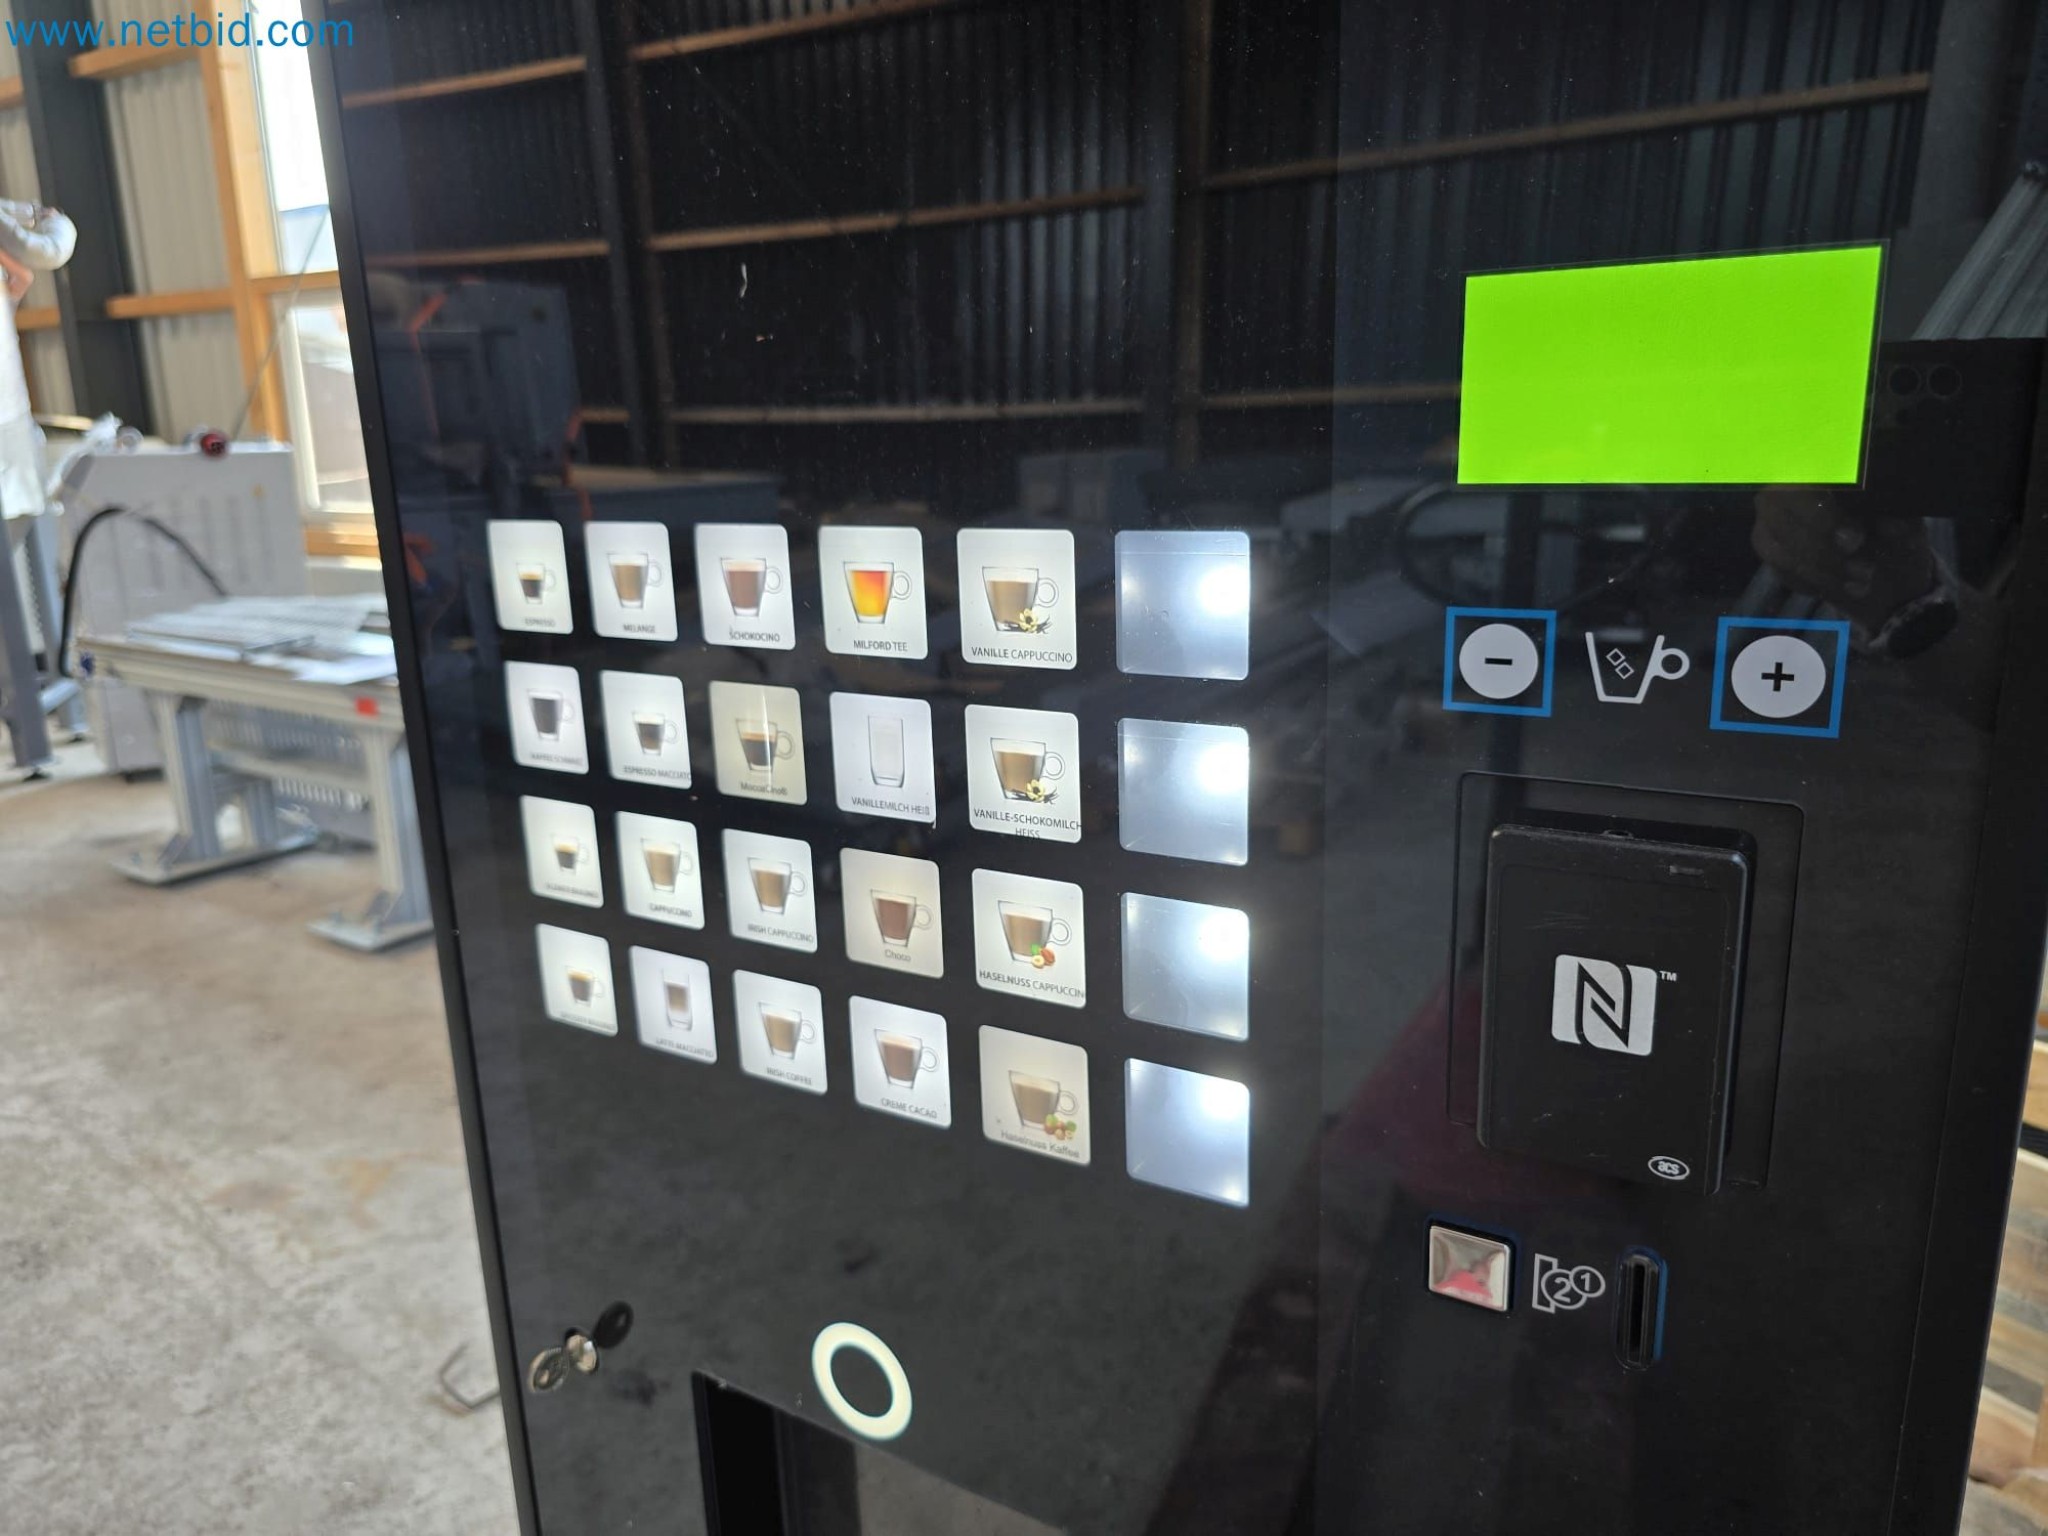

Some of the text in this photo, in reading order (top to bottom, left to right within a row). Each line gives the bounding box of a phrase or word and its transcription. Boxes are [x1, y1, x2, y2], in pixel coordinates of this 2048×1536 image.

[729, 631, 780, 642] SCHOKOCINO
[853, 639, 908, 652] MILFORD TEE
[971, 646, 1073, 663] VANILLE CAPPUCCINO
[623, 765, 657, 776] ESPRESSO
[851, 797, 910, 812] VANILLEMILCH
[973, 808, 1081, 831] VANILLE-SCHOKOMILCH
[1015, 827, 1041, 840] HEISS
[767, 927, 814, 943] CAPPUCCINO
[884, 949, 911, 961] Choco
[979, 970, 1031, 988] HASELNUSS
[881, 1098, 907, 1112] CREME
